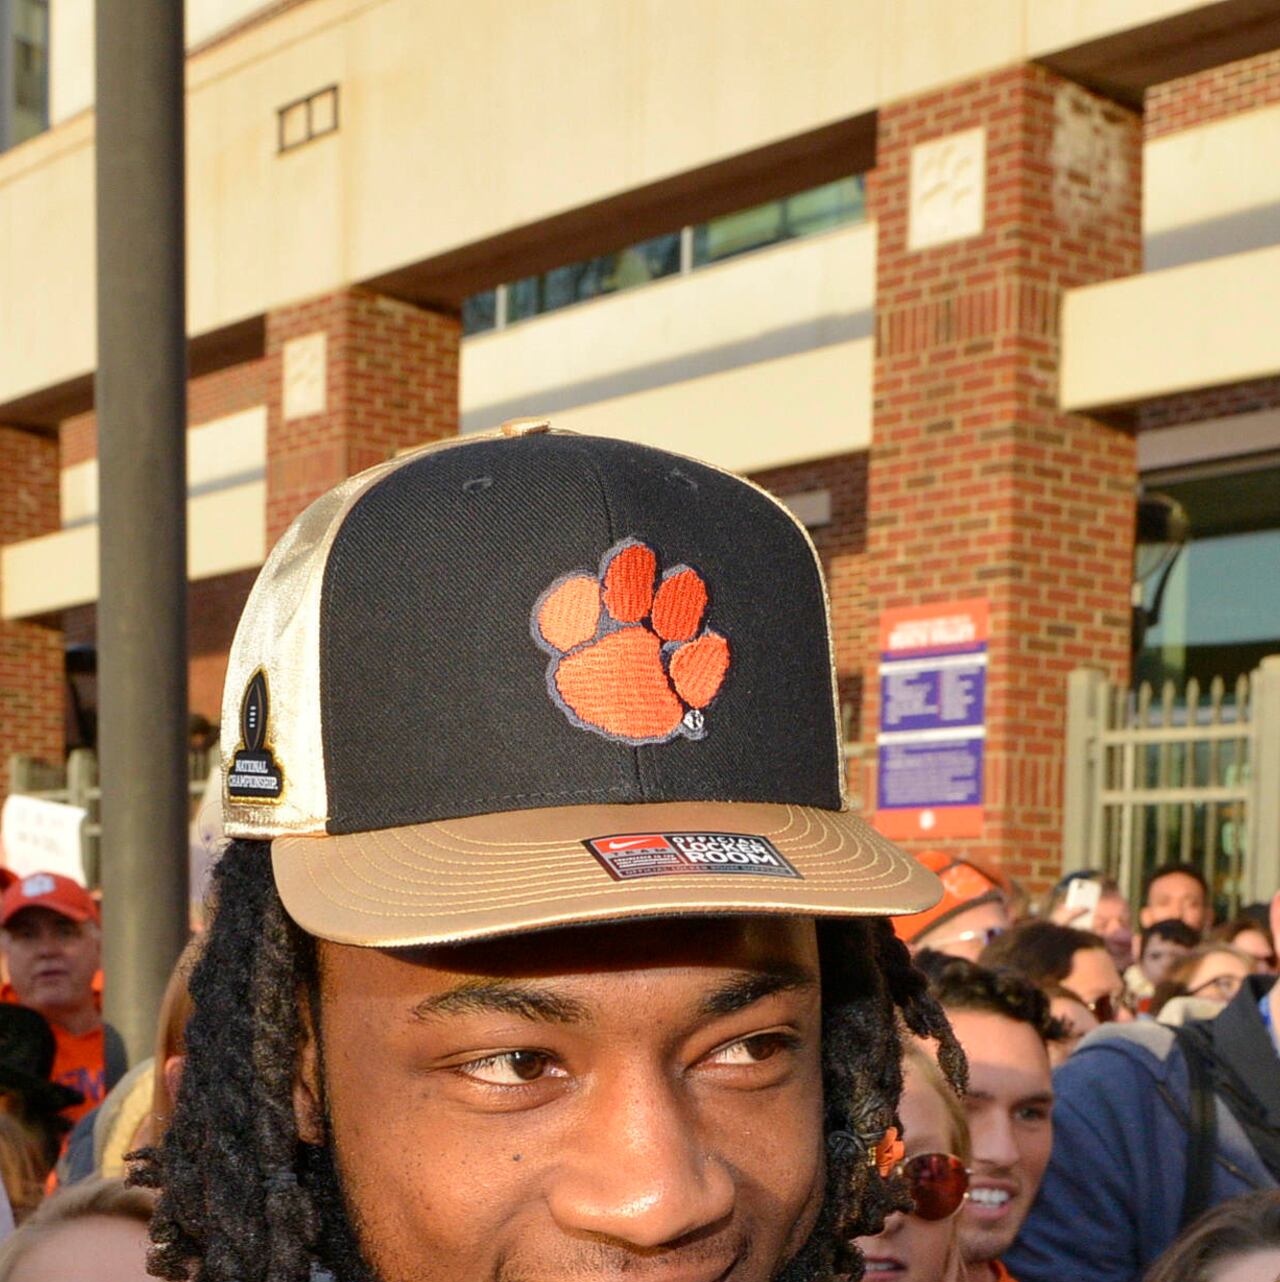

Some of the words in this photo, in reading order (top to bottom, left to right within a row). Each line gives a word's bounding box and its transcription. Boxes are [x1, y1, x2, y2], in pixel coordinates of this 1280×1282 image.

[672, 835, 757, 847] OFFICIAL
[676, 841, 768, 856] LOCKER
[684, 851, 782, 867] ROOM
